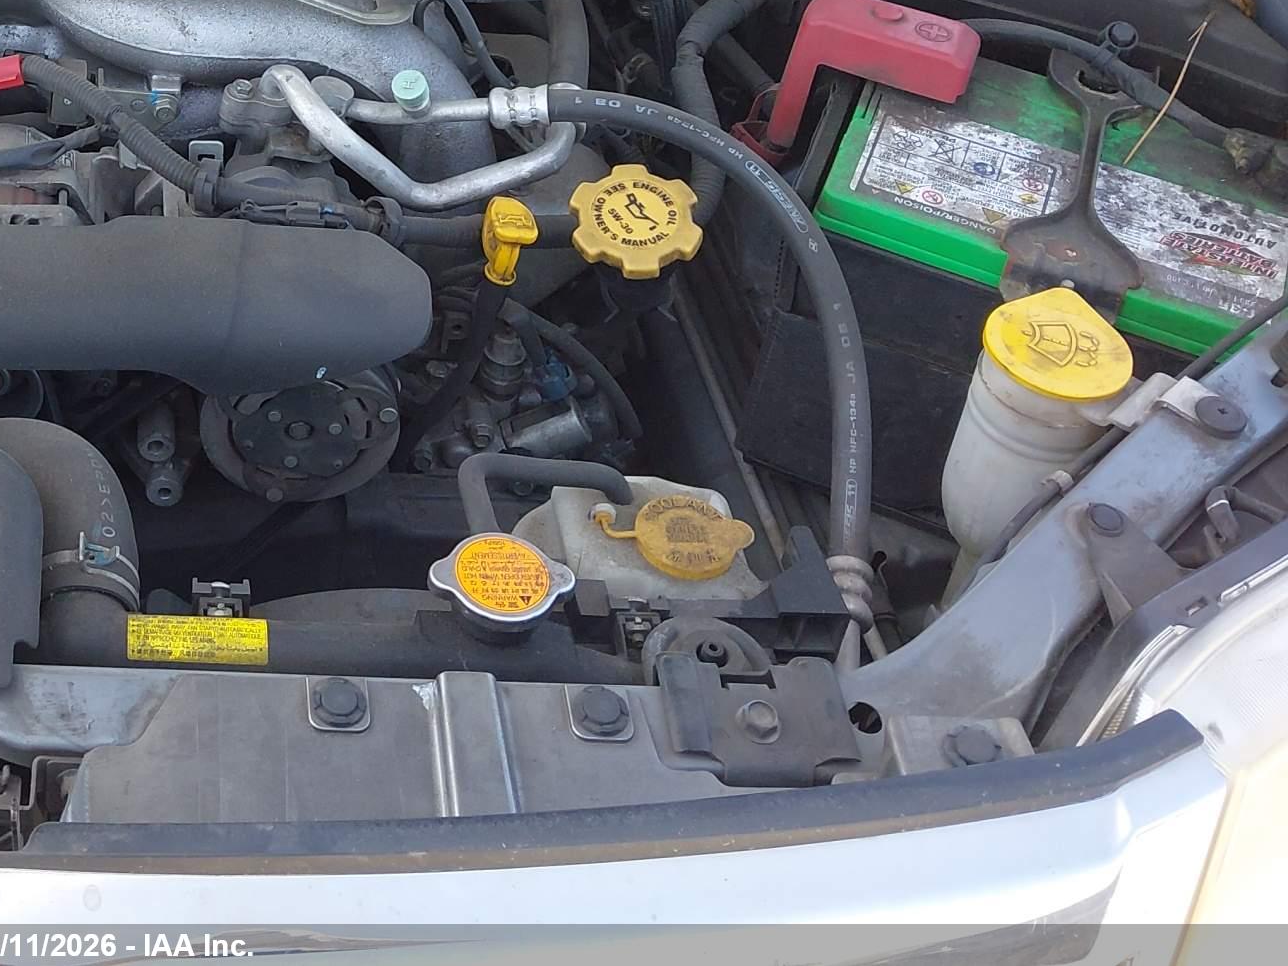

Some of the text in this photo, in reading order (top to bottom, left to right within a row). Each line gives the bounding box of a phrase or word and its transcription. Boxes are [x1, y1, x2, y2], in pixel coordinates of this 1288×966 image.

[594, 182, 670, 246] SEE OWNER'S MANUAL
[607, 208, 634, 234] 5W-30
[632, 181, 677, 225] ENGINE OIL
[894, 196, 996, 235] DANGER/POISON
[1172, 212, 1278, 249] AUTOMOTIVE
